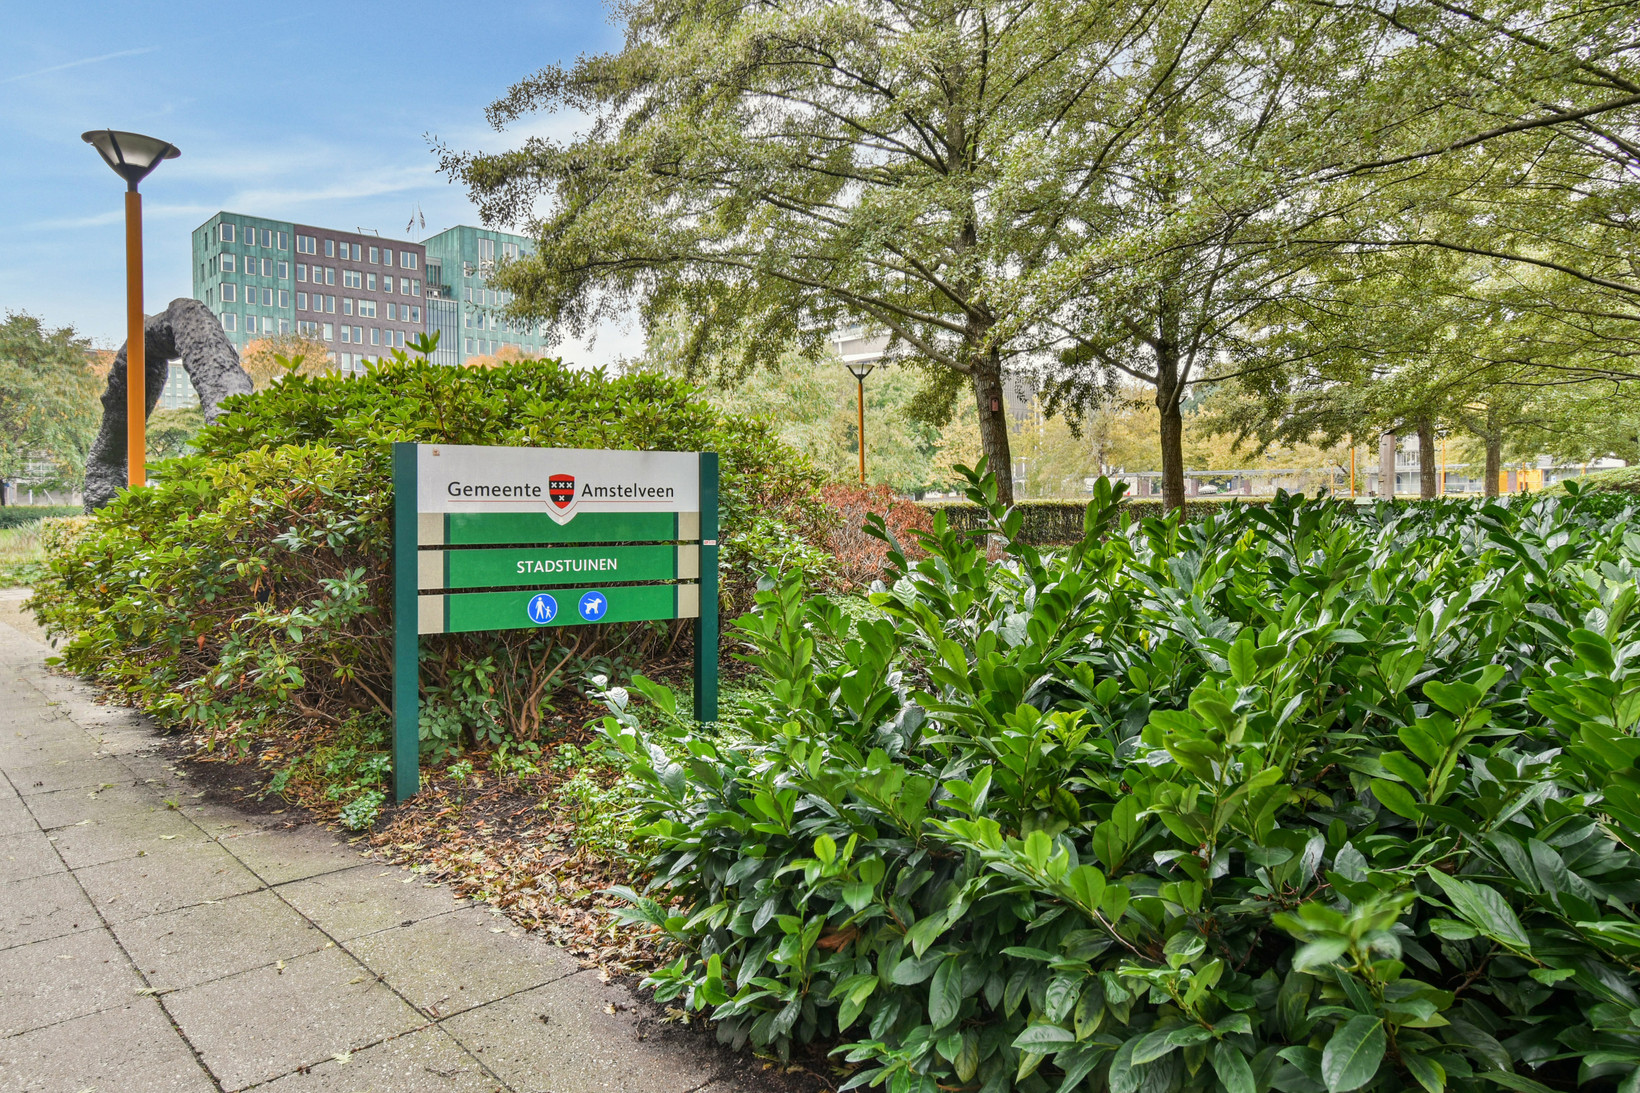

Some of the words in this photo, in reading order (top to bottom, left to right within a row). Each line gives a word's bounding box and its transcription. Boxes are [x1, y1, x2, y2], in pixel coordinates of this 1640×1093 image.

[447, 481, 542, 498] Gemeente
[581, 482, 674, 498] Amstelveen
[516, 558, 618, 574] STADSTUINEN
